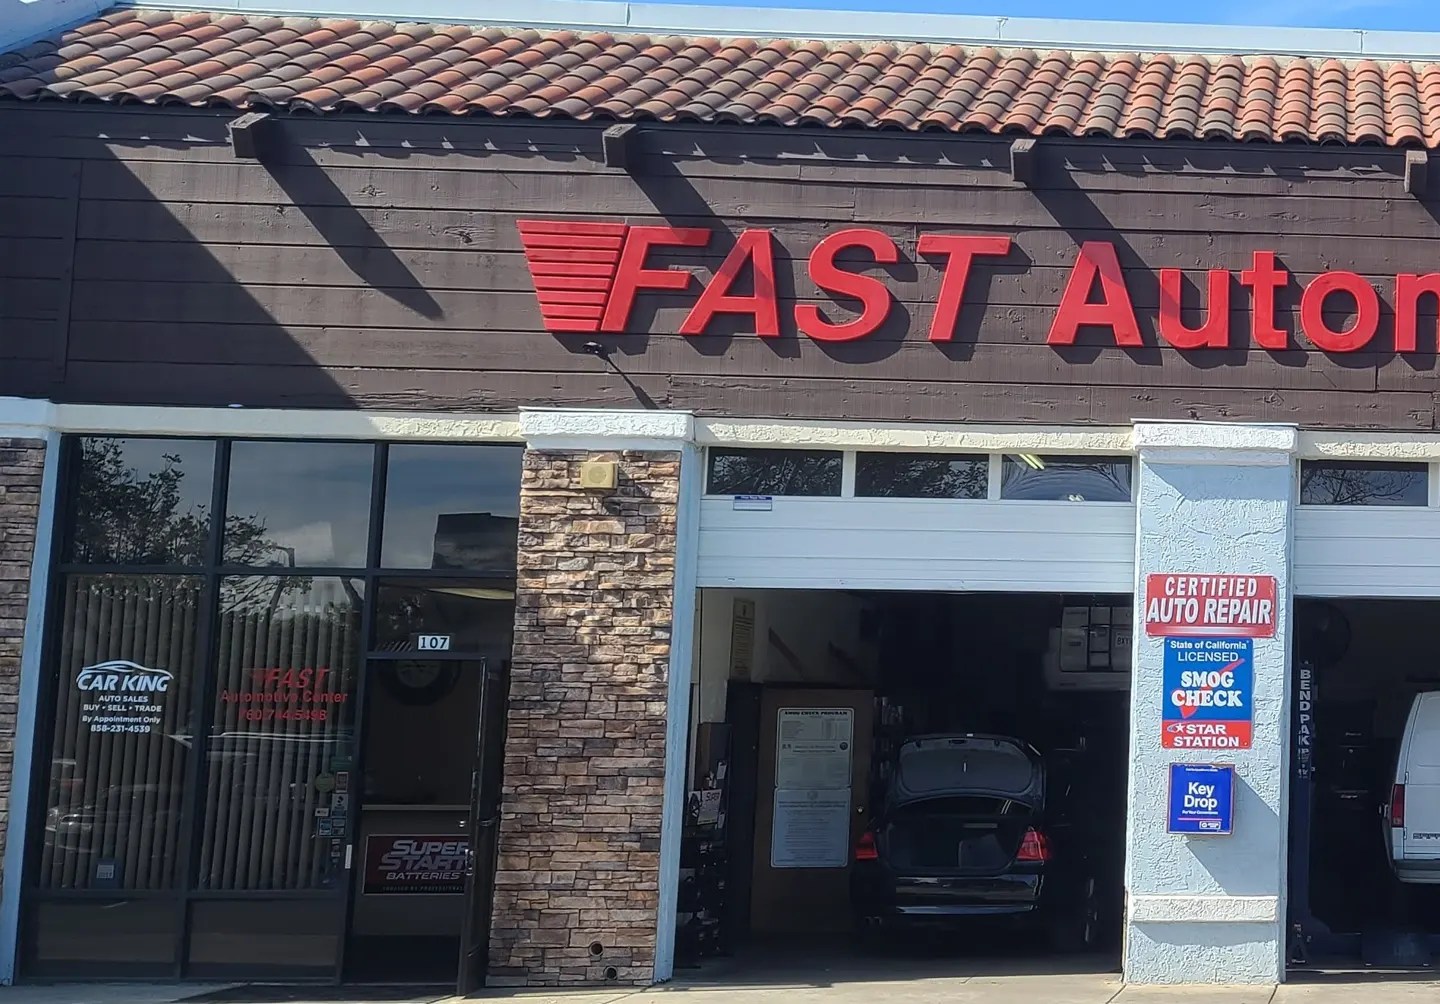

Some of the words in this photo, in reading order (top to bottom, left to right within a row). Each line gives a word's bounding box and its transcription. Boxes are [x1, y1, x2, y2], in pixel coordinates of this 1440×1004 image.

[601, 226, 1013, 342] FAST
[1165, 577, 1258, 597] CERTIFIED
[1146, 597, 1199, 623] AUTO
[1203, 599, 1271, 624] REPAIR
[420, 636, 448, 649] 107
[1170, 640, 1193, 649] State
[1194, 640, 1204, 649] of
[1205, 640, 1247, 650] California
[1177, 652, 1239, 662] LICENSED
[78, 674, 119, 691] CAR
[121, 673, 170, 692] KING
[264, 667, 331, 688] FAST
[1181, 671, 1235, 688] SMOG
[123, 695, 149, 703] SALES
[1171, 690, 1243, 707] CHECK
[107, 704, 127, 712] SELL
[135, 704, 162, 712] TRADE
[82, 715, 91, 724] By
[94, 715, 142, 724] Appointment
[143, 715, 161, 724] Only
[1186, 724, 1227, 735] STAR
[1173, 736, 1240, 748] STATION
[1188, 782, 1215, 798] Key
[1184, 795, 1218, 811] Drop
[386, 872, 461, 880] BATTERIES
